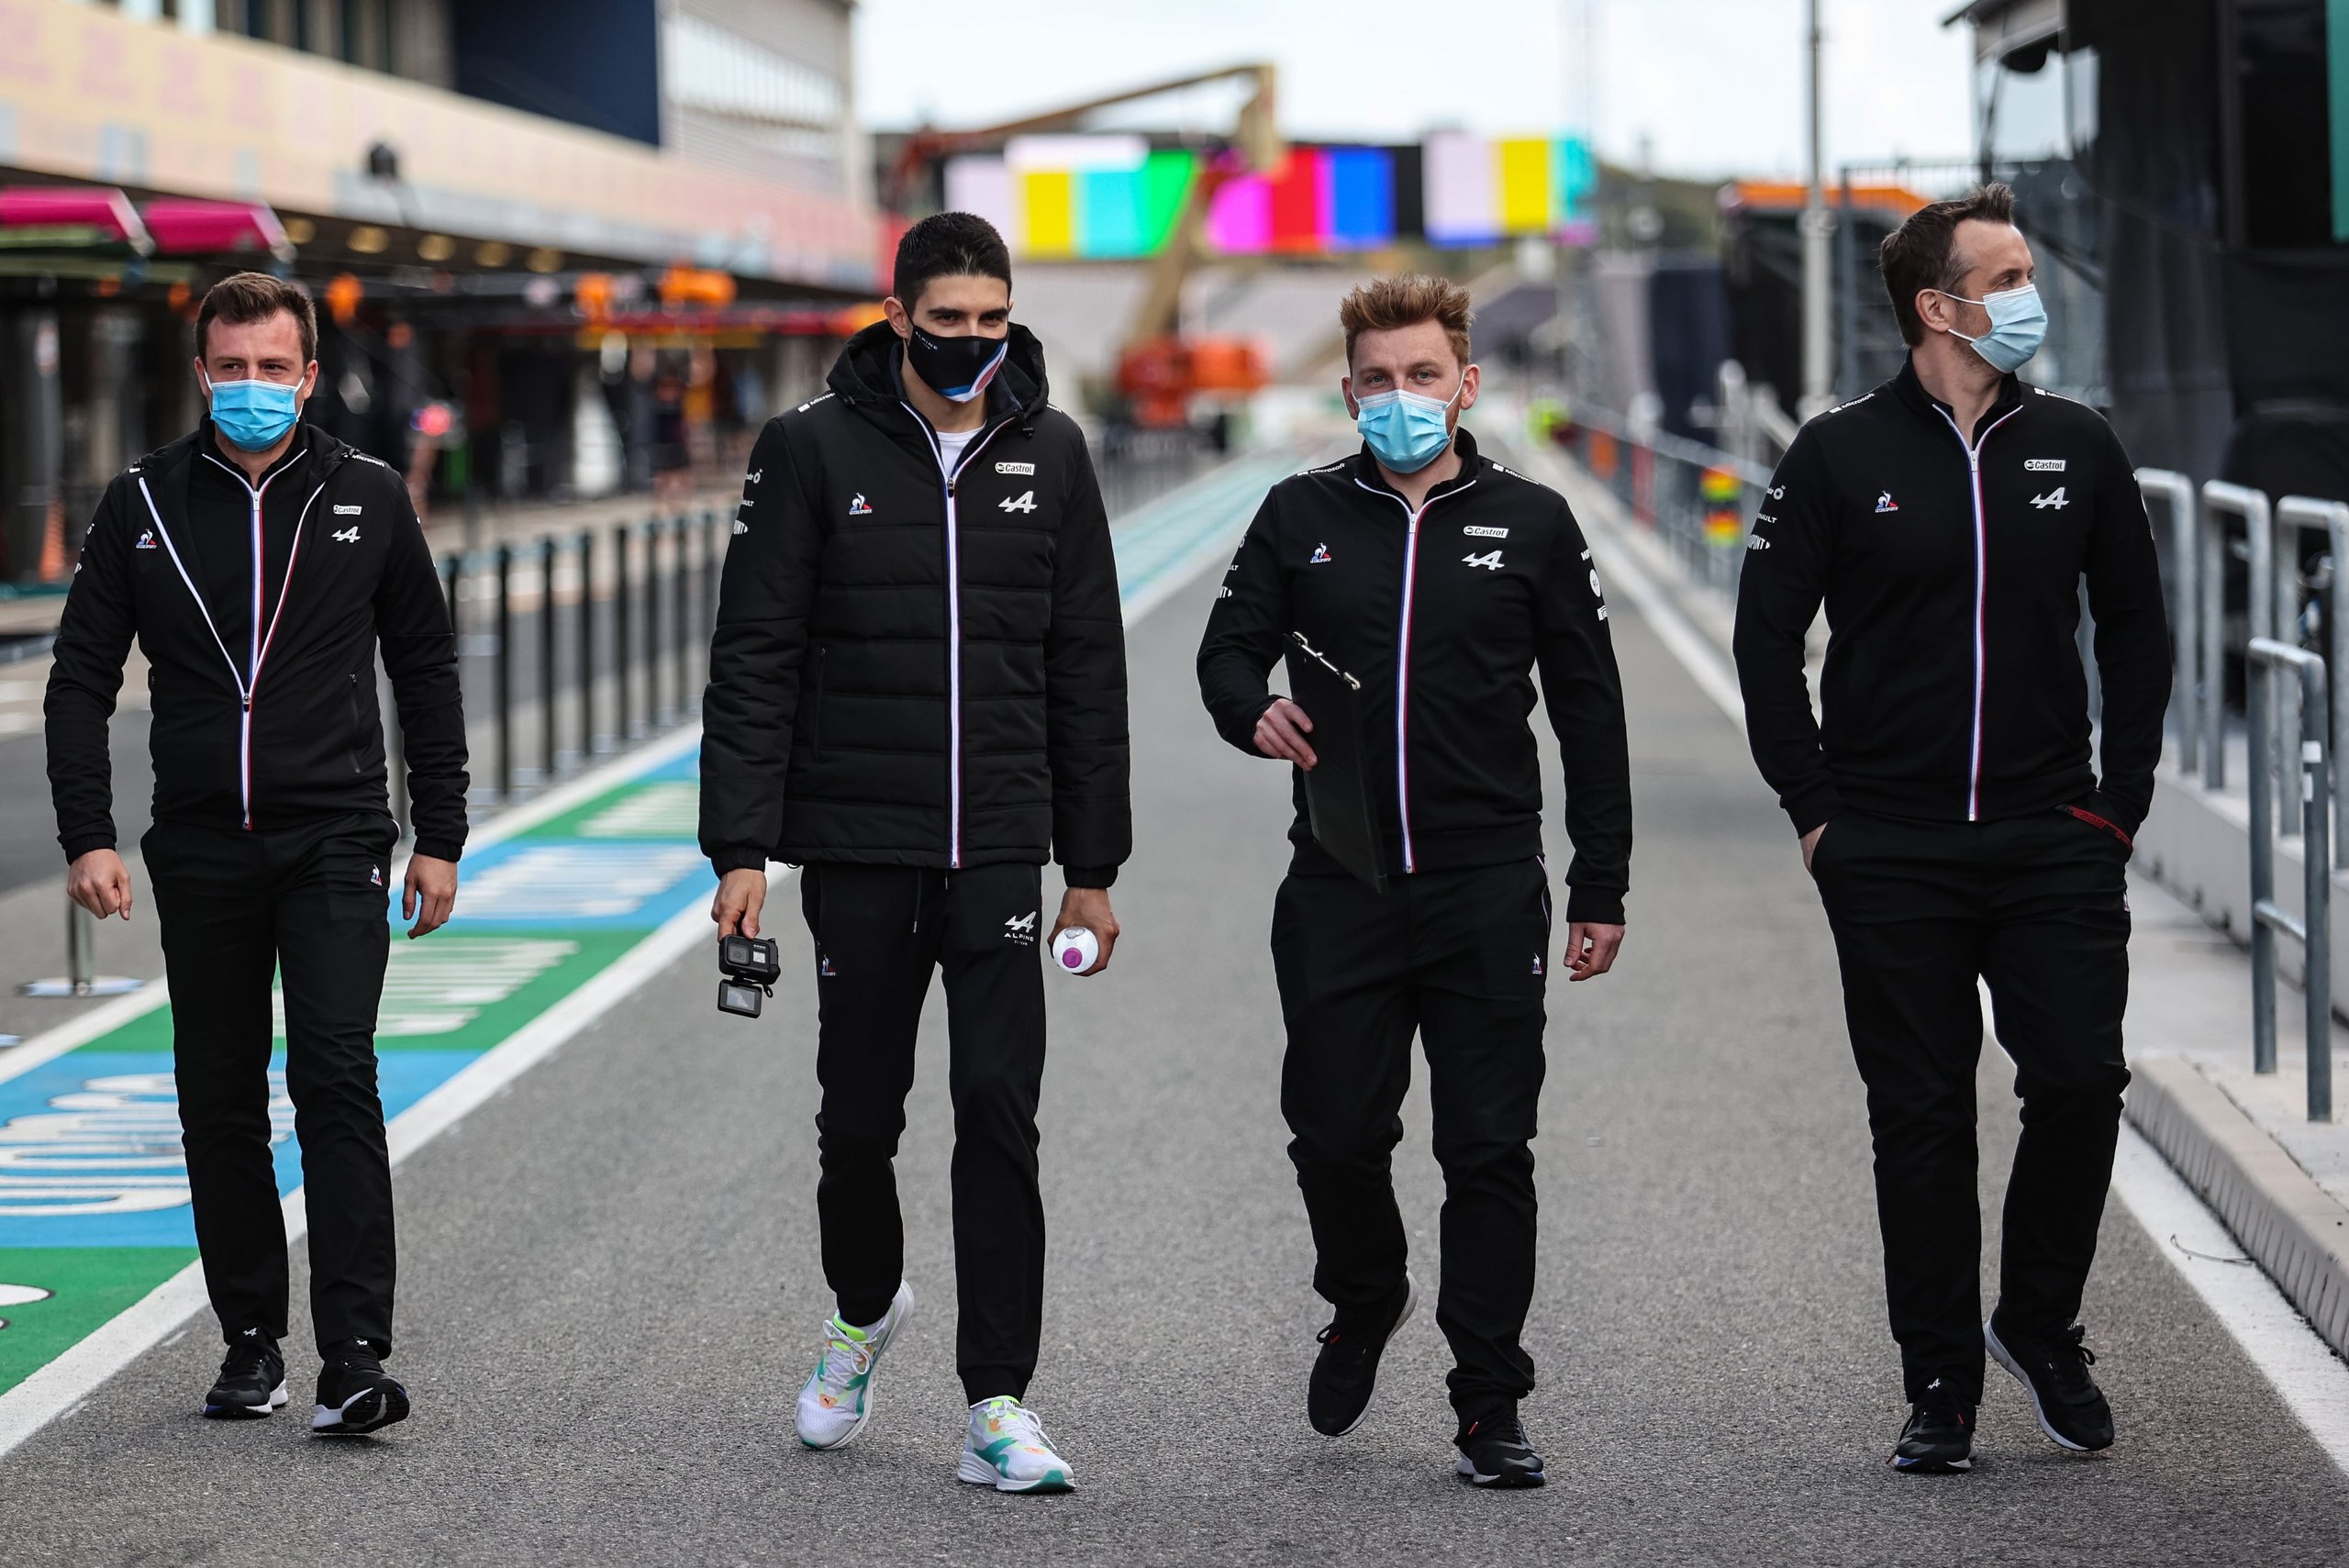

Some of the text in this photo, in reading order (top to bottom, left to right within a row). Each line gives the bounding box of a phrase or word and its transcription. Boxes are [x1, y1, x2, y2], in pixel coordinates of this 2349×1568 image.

[1005, 463, 1032, 473] Castrol
[1309, 462, 1346, 474] Microsoft
[2034, 461, 2063, 471] Castrol
[1474, 528, 1505, 537] Castrol
[1004, 932, 1034, 942] ALPINE
